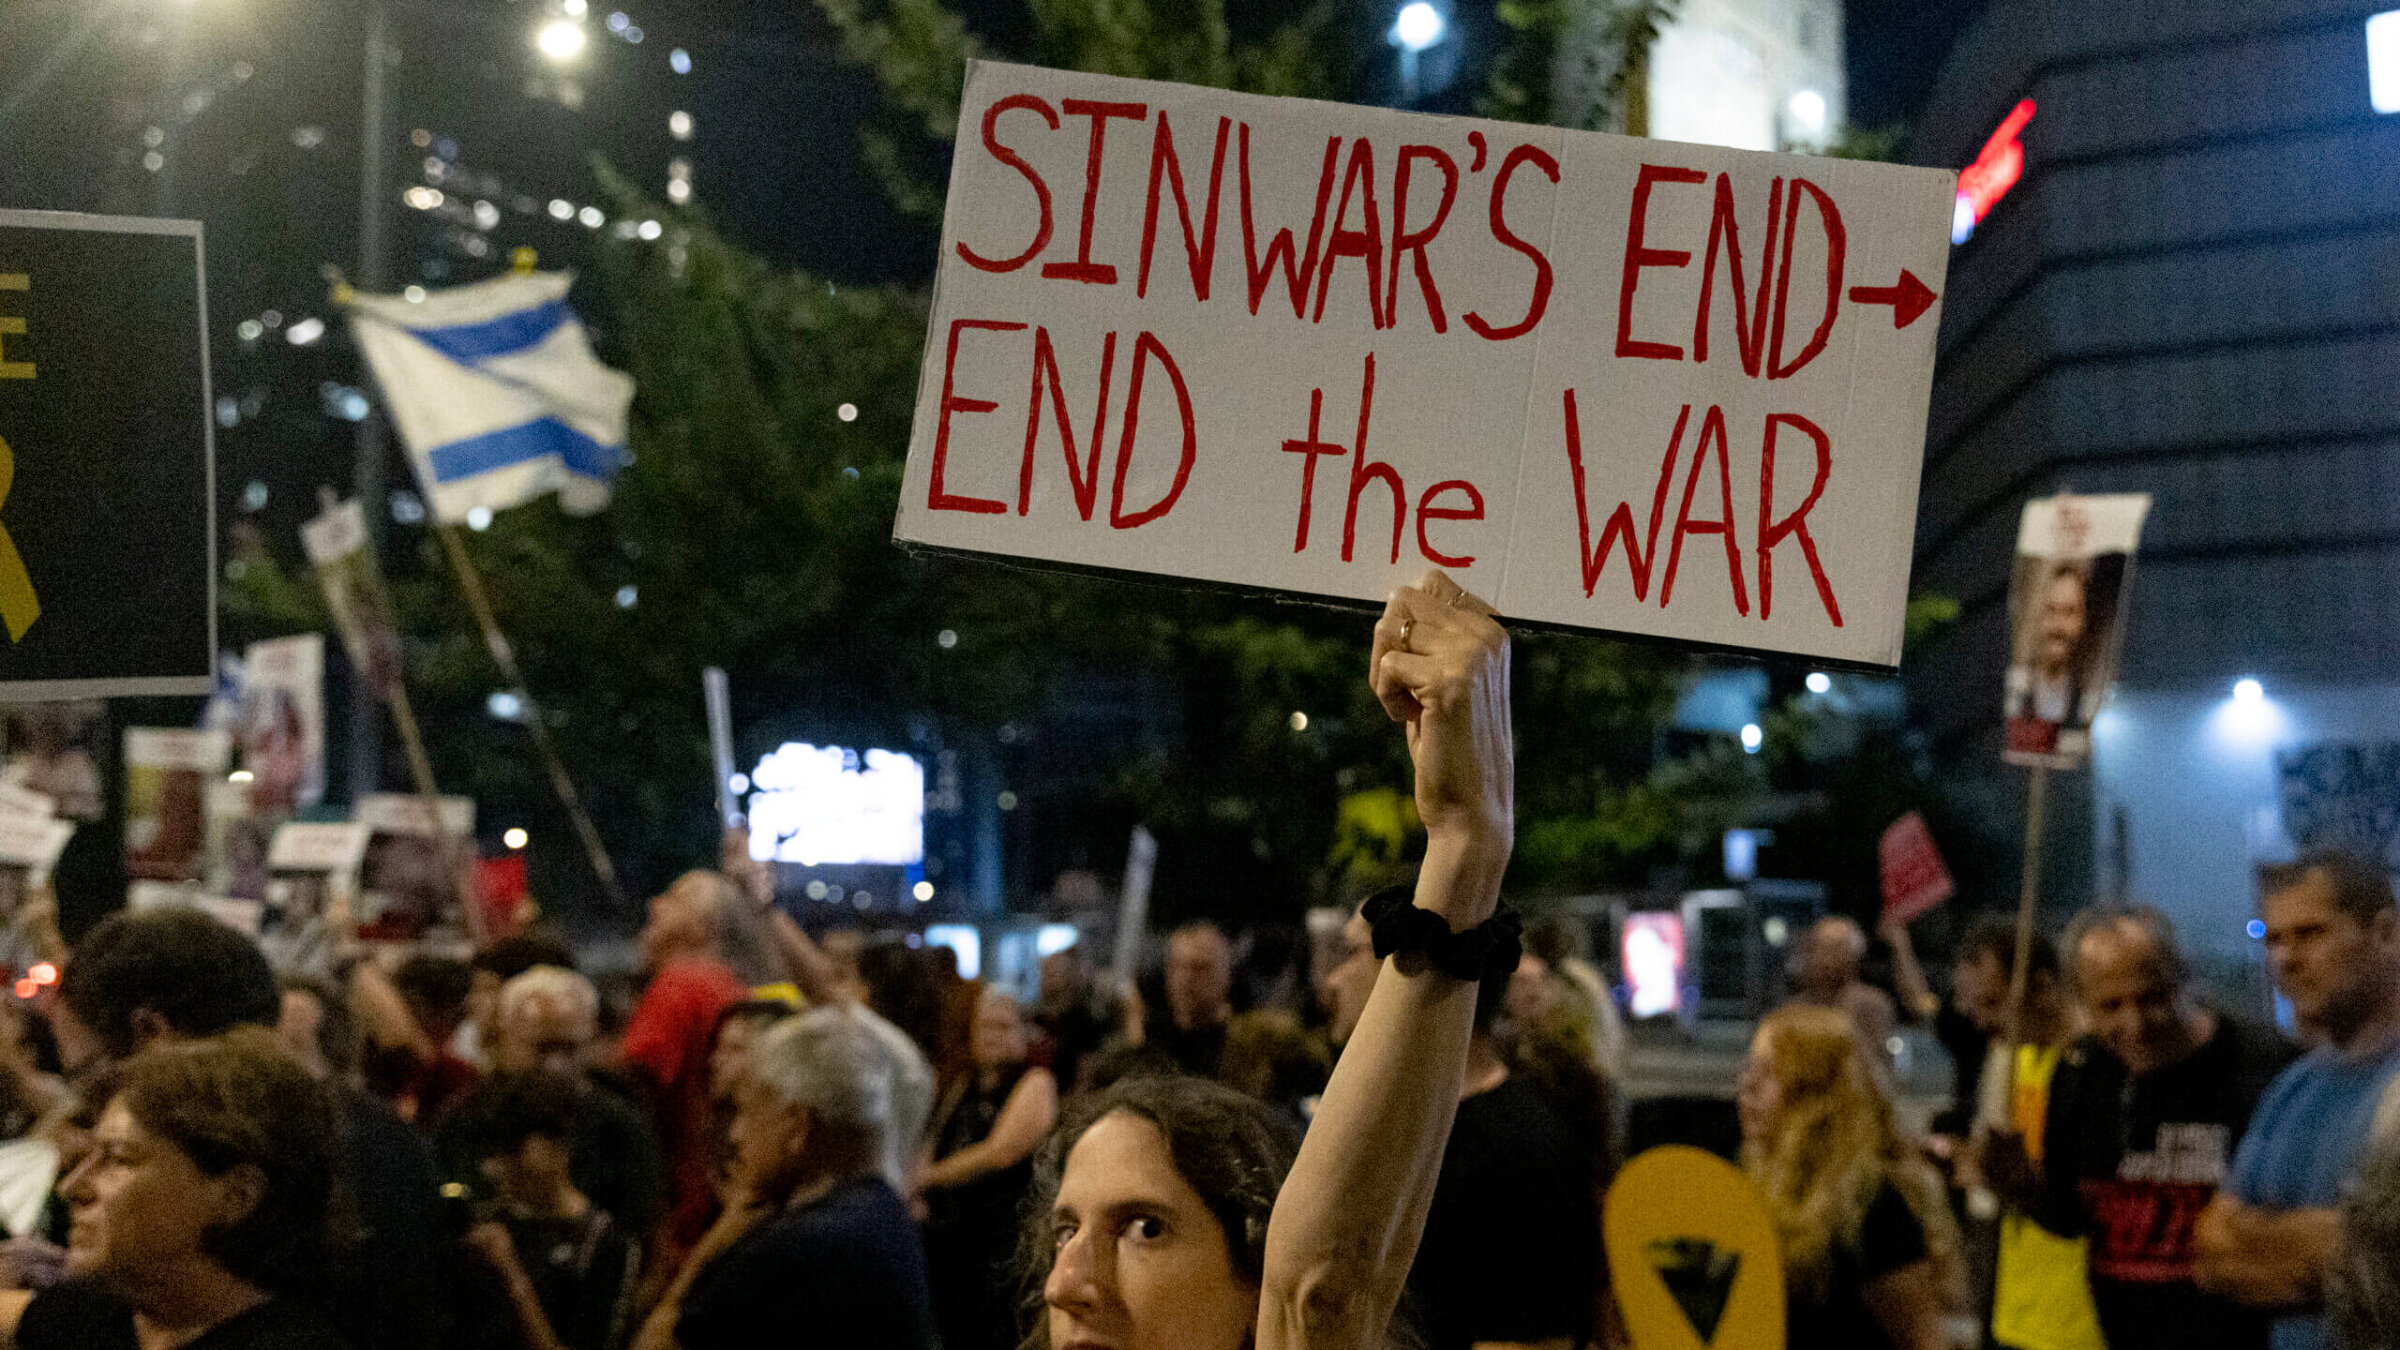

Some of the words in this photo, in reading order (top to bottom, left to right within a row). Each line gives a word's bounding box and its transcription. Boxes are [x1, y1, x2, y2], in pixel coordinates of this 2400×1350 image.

[957, 93, 1561, 342] SINWAR'S
[1614, 163, 1846, 381] END
[927, 318, 1197, 529] END
[1281, 351, 1485, 567] the
[1563, 387, 1845, 629] WAR
